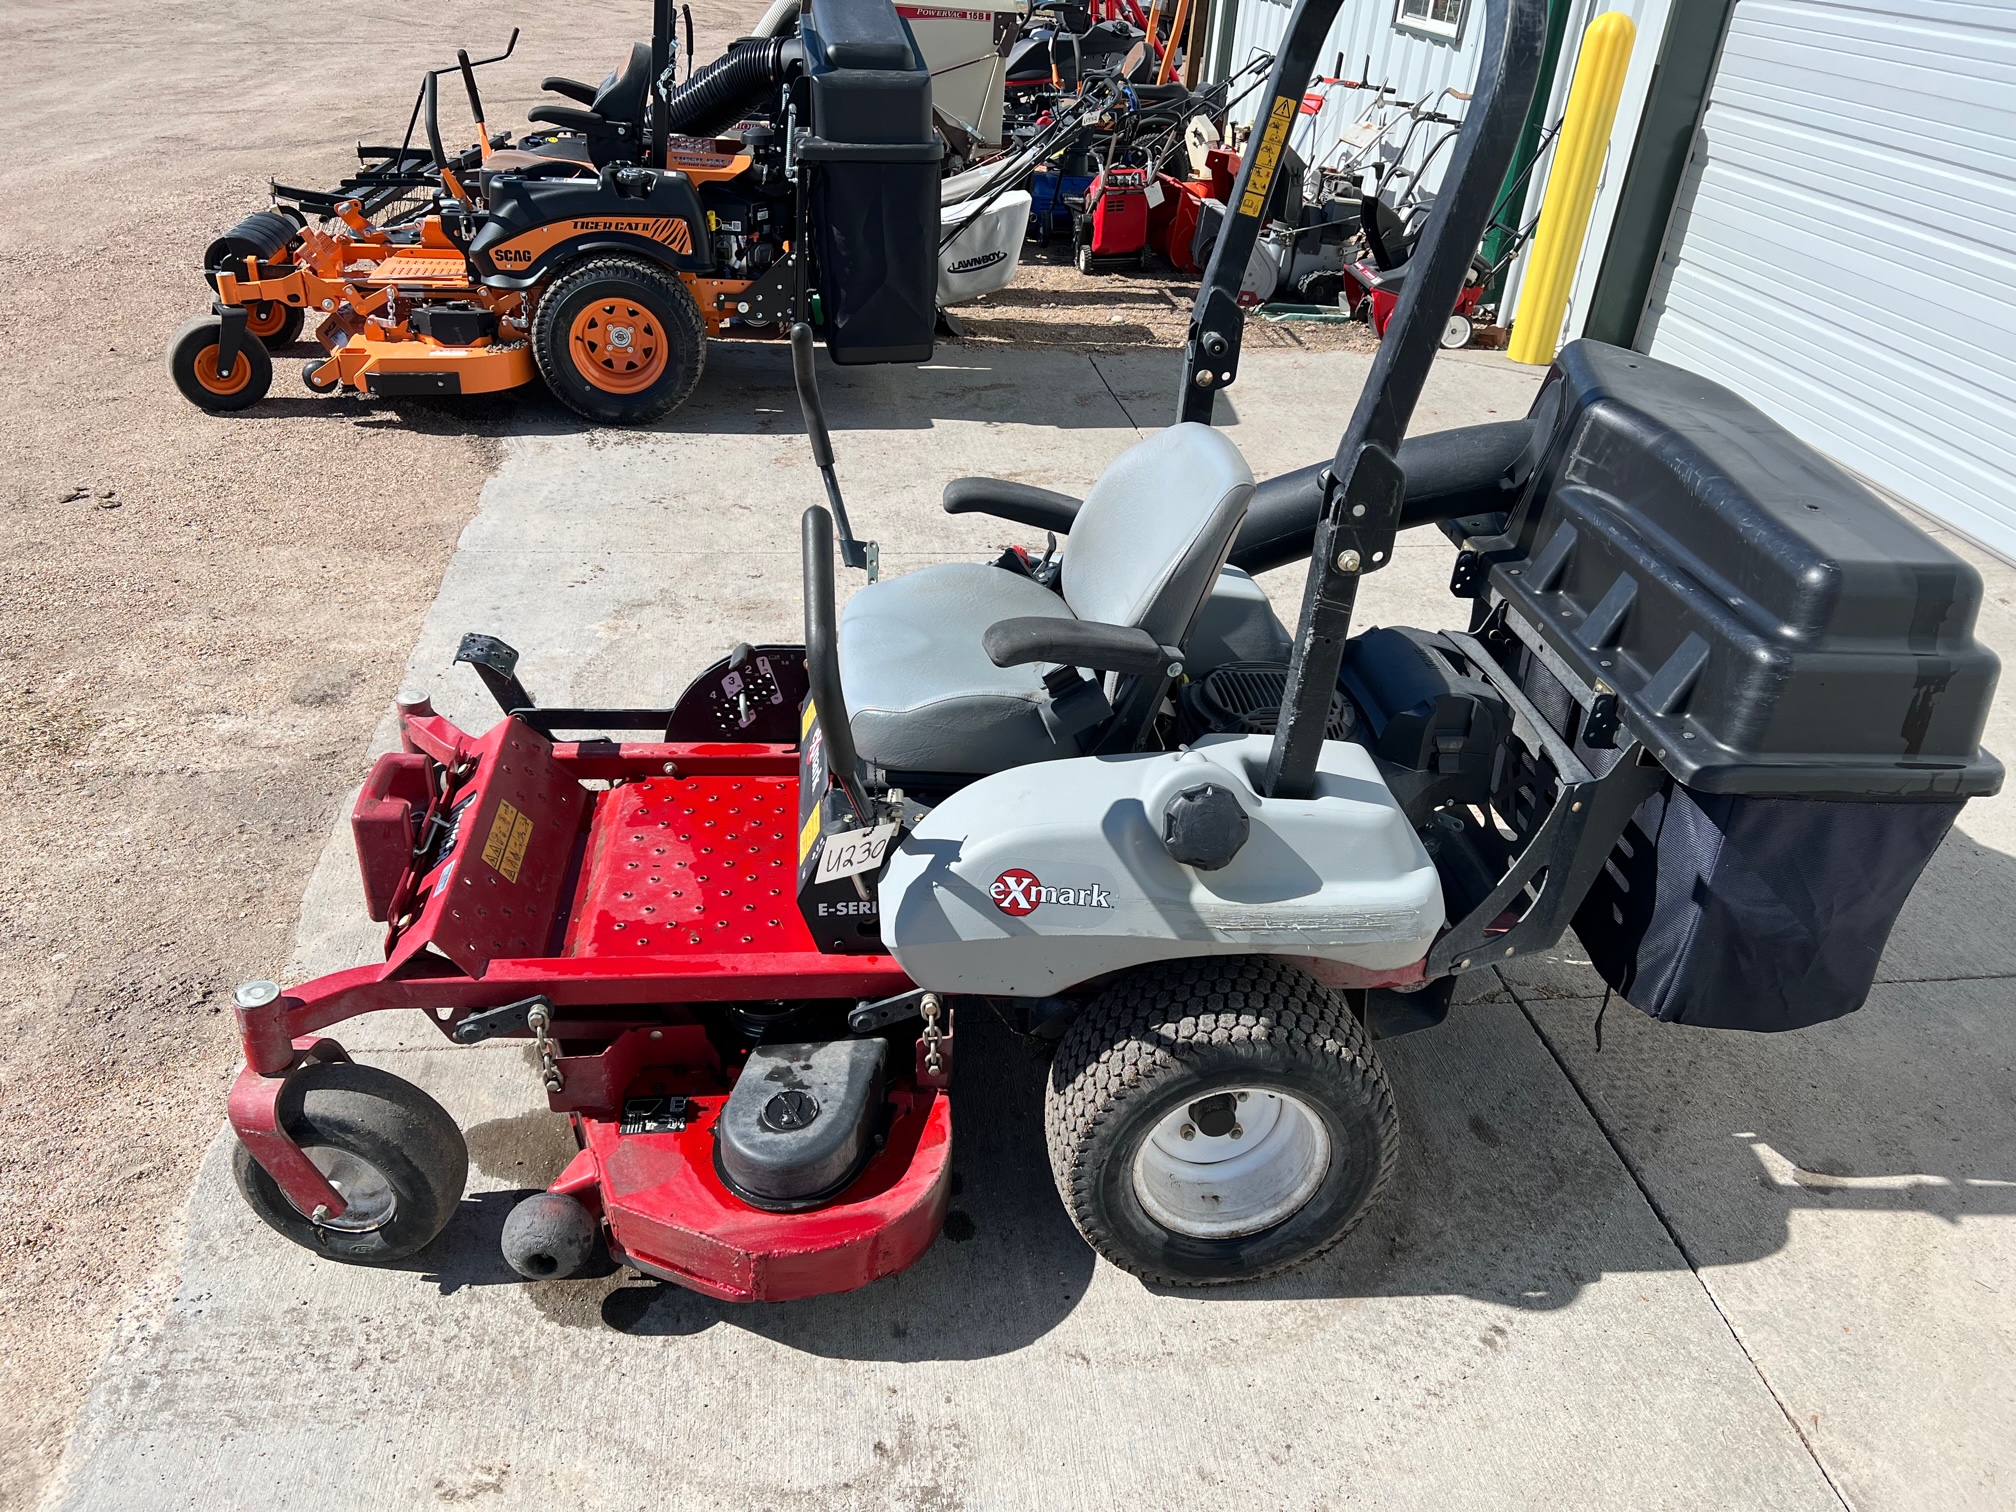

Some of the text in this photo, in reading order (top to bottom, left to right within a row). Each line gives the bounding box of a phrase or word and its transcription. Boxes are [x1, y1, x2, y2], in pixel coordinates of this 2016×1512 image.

[572, 221, 613, 230] TIGER
[614, 222, 641, 231] CAT
[494, 250, 532, 262] SCAG
[745, 665, 752, 674] 2
[728, 677, 735, 685] 3
[709, 691, 717, 699] 4
[826, 839, 886, 873] U230
[818, 901, 877, 916] E-SERI
